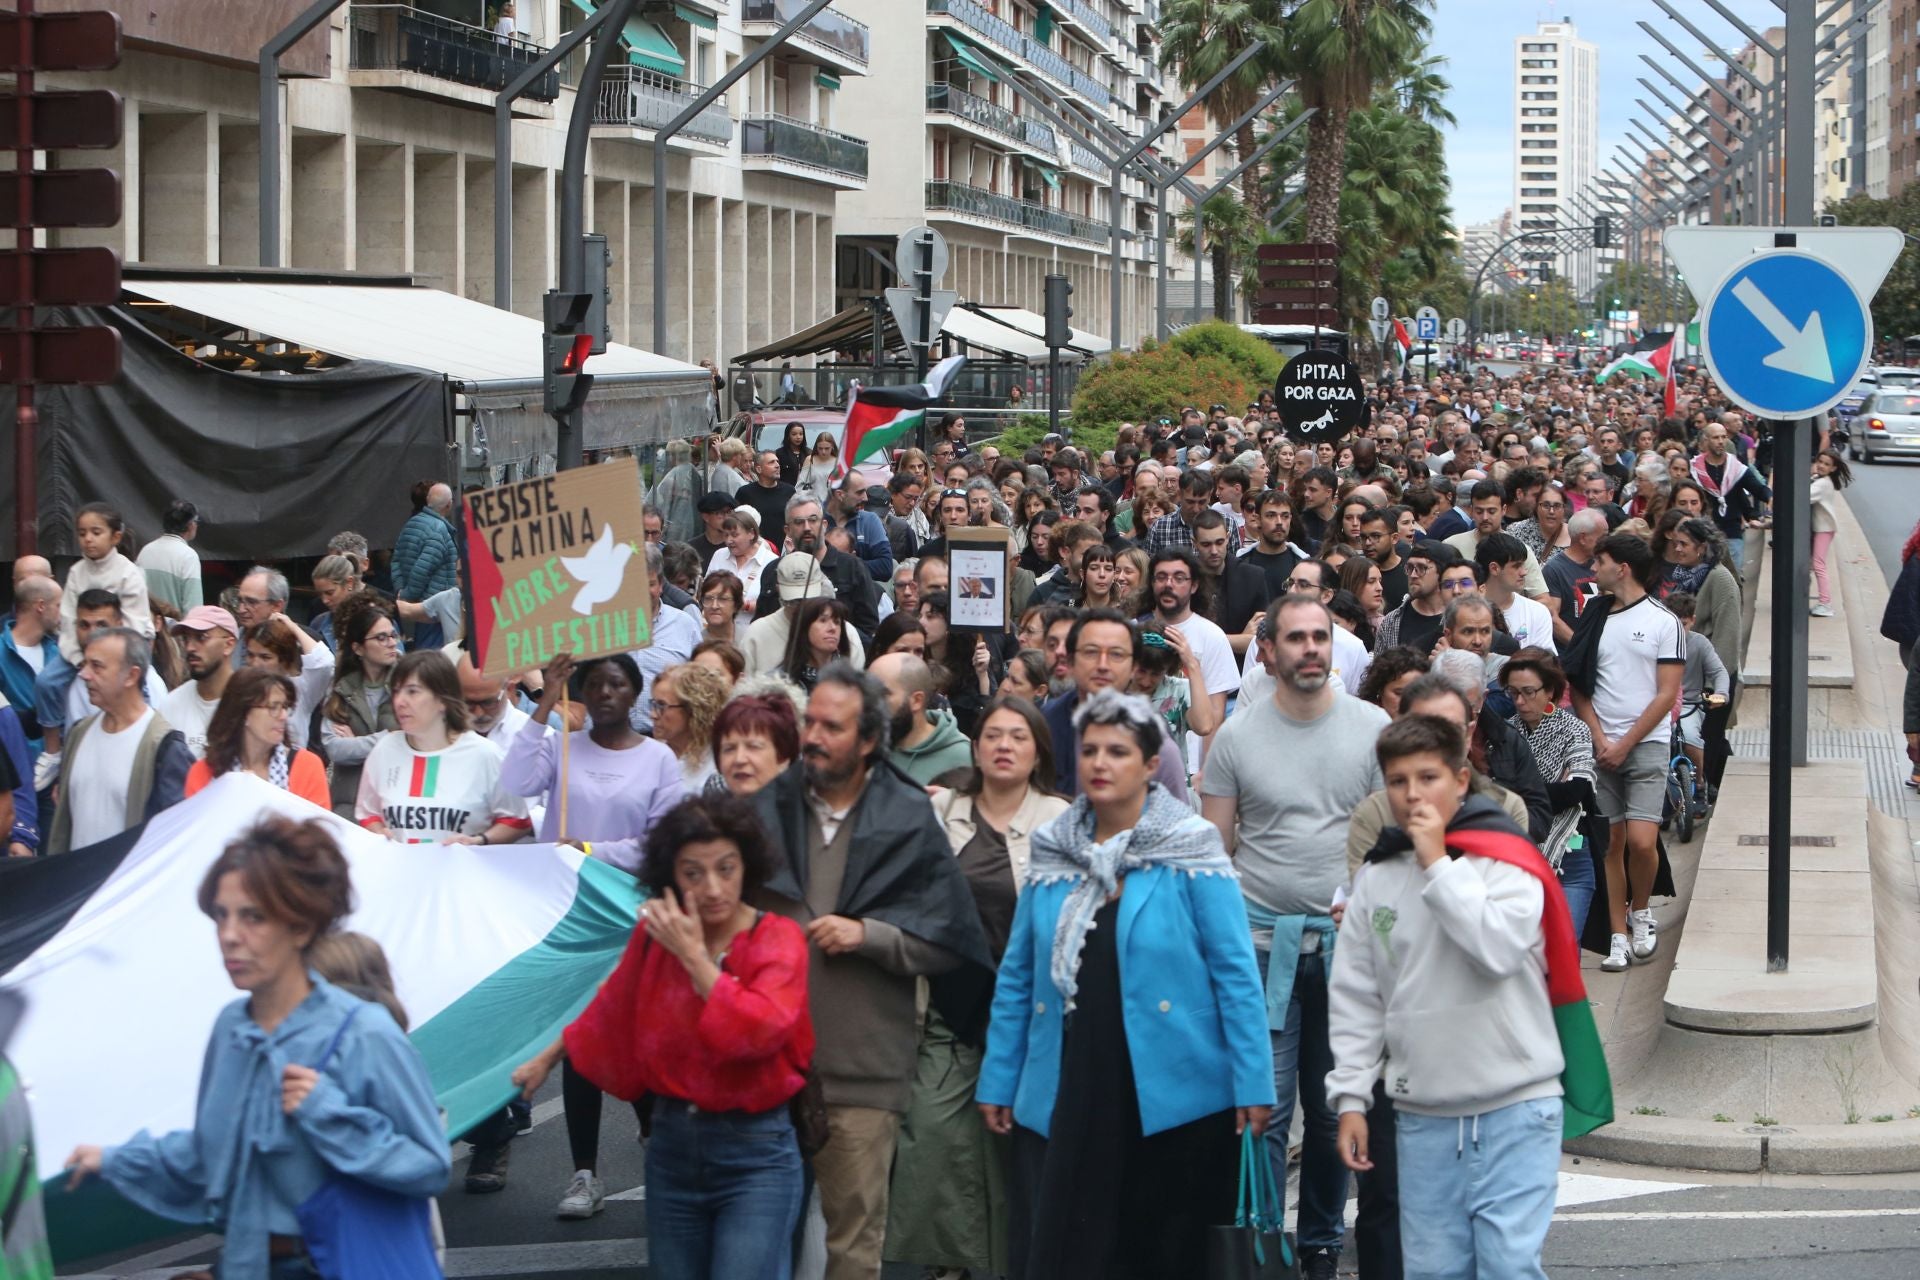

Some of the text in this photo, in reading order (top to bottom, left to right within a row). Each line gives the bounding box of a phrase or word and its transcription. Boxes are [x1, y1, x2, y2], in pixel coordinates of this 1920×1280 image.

[1421, 320, 1433, 336] P
[1284, 385, 1356, 401] POR GAZA
[1296, 364, 1345, 381] ¡PITA!
[470, 477, 559, 529] RESISTE
[491, 507, 595, 563] CAMINA
[491, 556, 570, 630] LIBRE
[505, 607, 651, 668] PALESTINA
